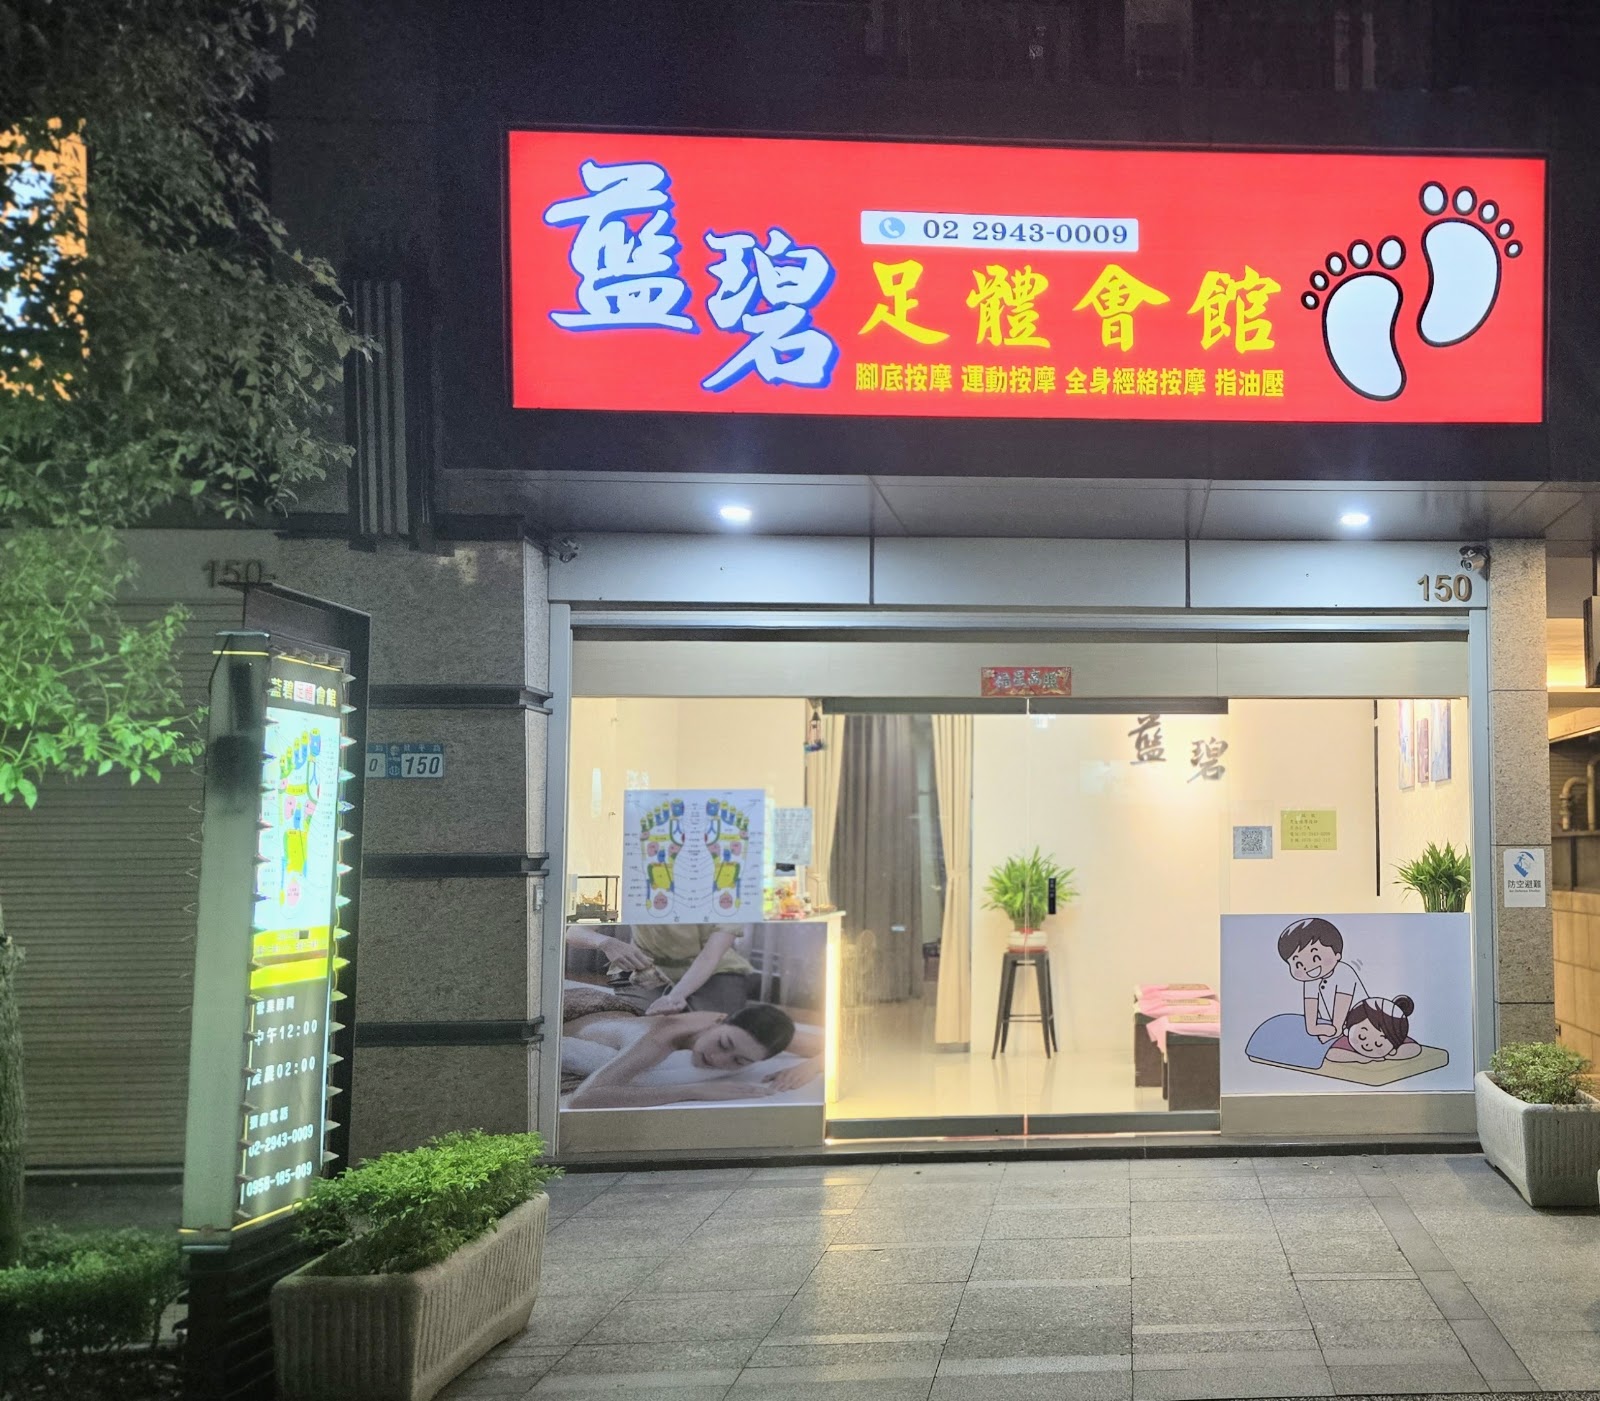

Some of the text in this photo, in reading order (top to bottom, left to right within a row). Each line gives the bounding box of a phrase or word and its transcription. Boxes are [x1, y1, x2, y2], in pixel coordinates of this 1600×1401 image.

[922, 218, 1129, 244] 02 2943-0009
[543, 157, 840, 392] 藍碧
[857, 258, 1282, 354] 足體會館
[855, 362, 1285, 398] 腳底按摩 運動按摩 全身經絡按摩 指油壓
[1417, 574, 1472, 602] 150
[405, 756, 440, 775] 150
[1128, 714, 1229, 783] 藍碧
